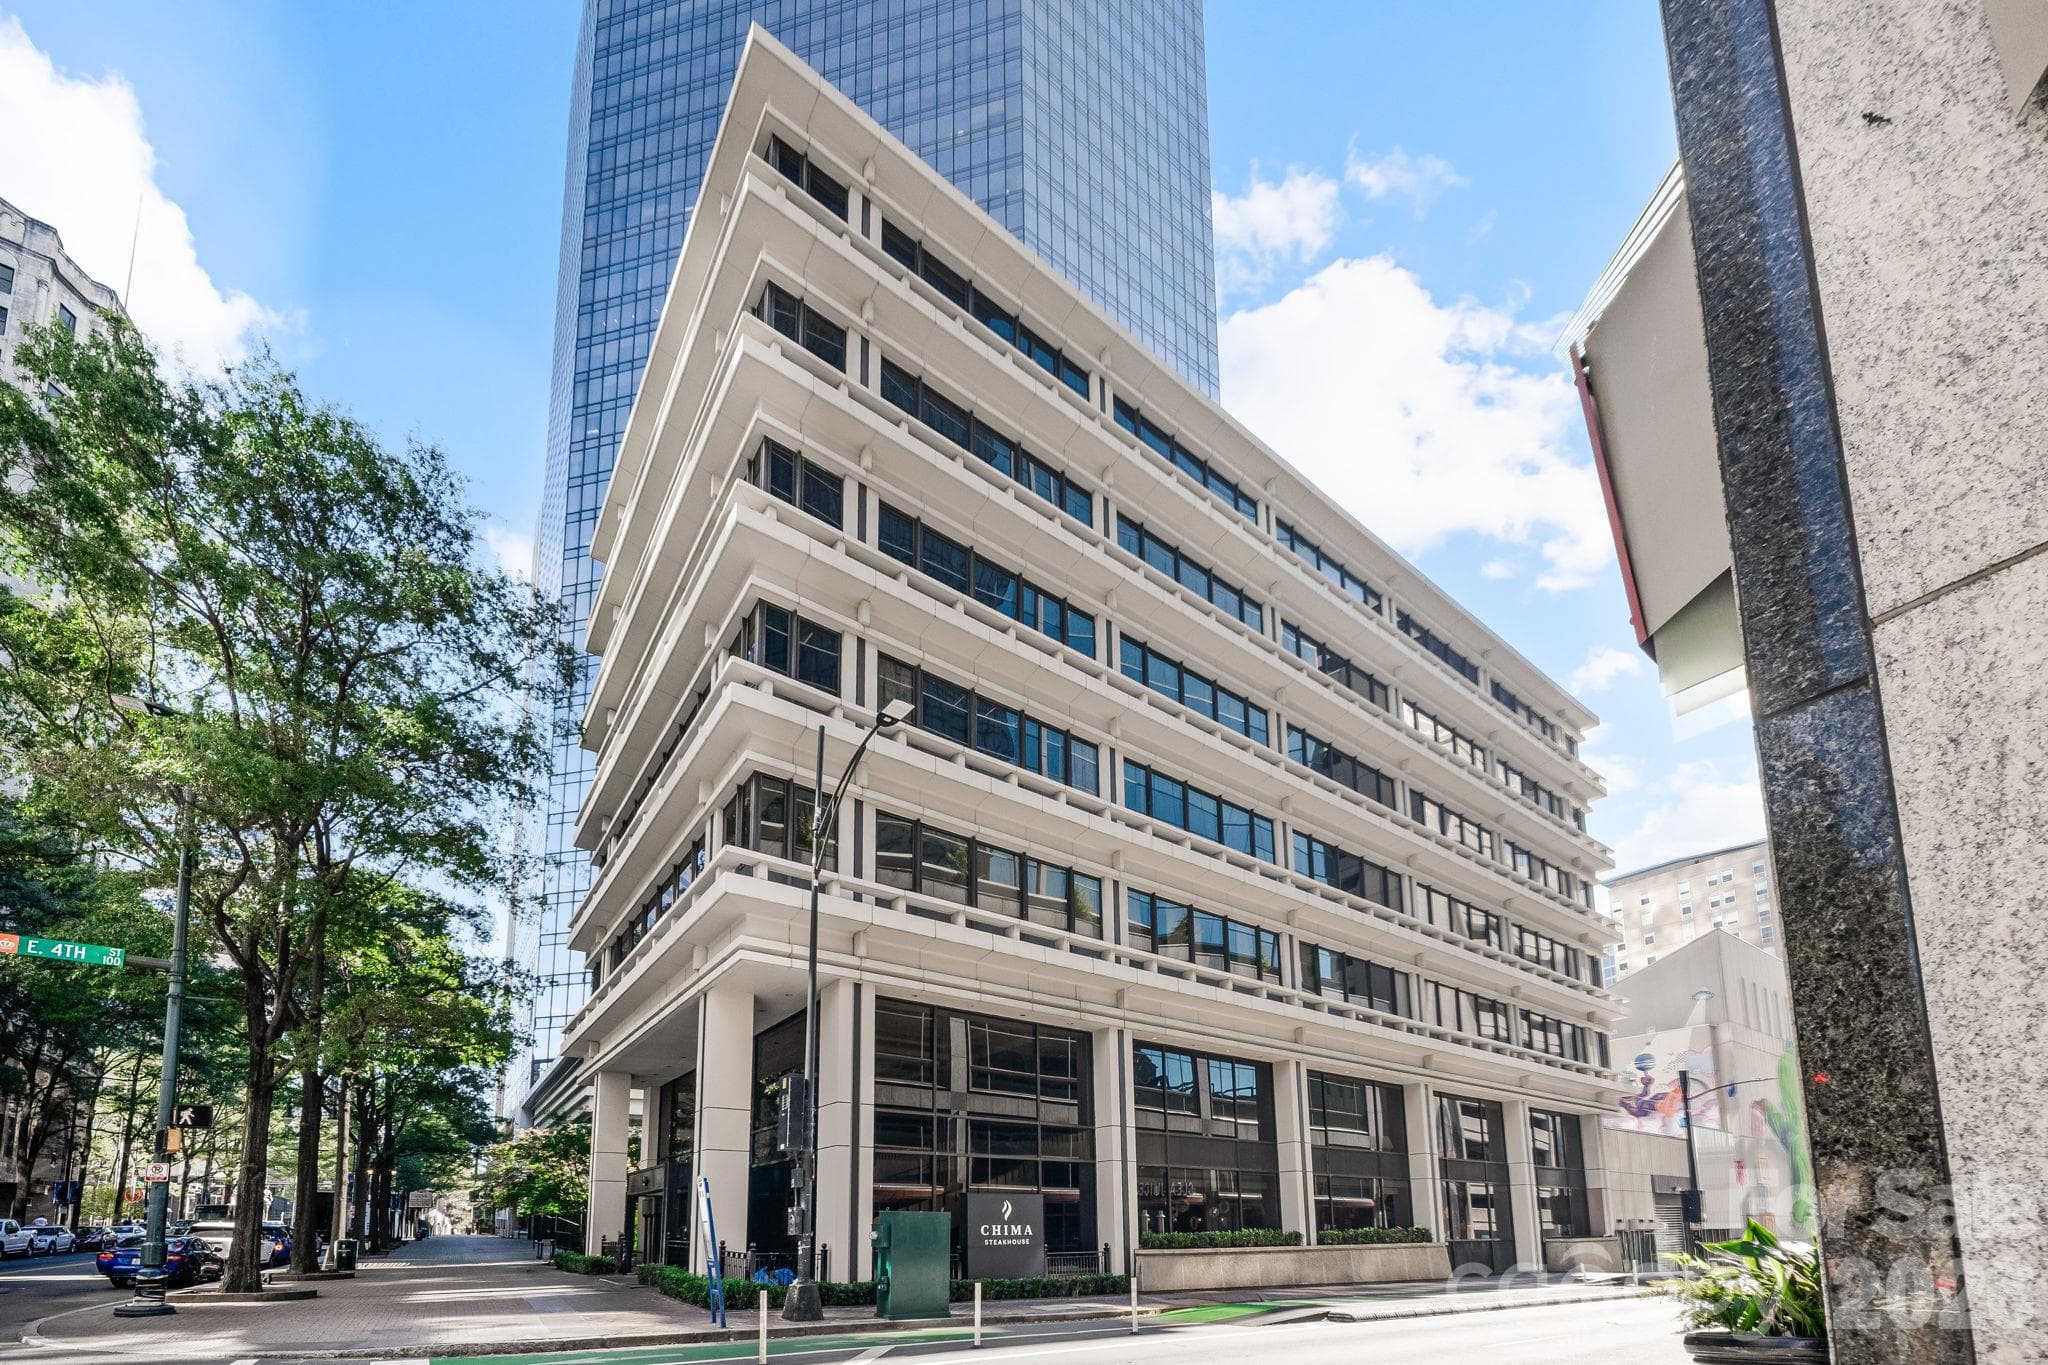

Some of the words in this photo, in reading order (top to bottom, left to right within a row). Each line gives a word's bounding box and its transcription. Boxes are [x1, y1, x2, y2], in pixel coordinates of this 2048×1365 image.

[27, 940, 43, 955] E.
[50, 943, 86, 960] 4TH
[109, 947, 123, 957] ST
[102, 956, 121, 966] 100
[980, 1224, 1033, 1236] CHIMA
[984, 1238, 1030, 1246] STEAKHOUSE
